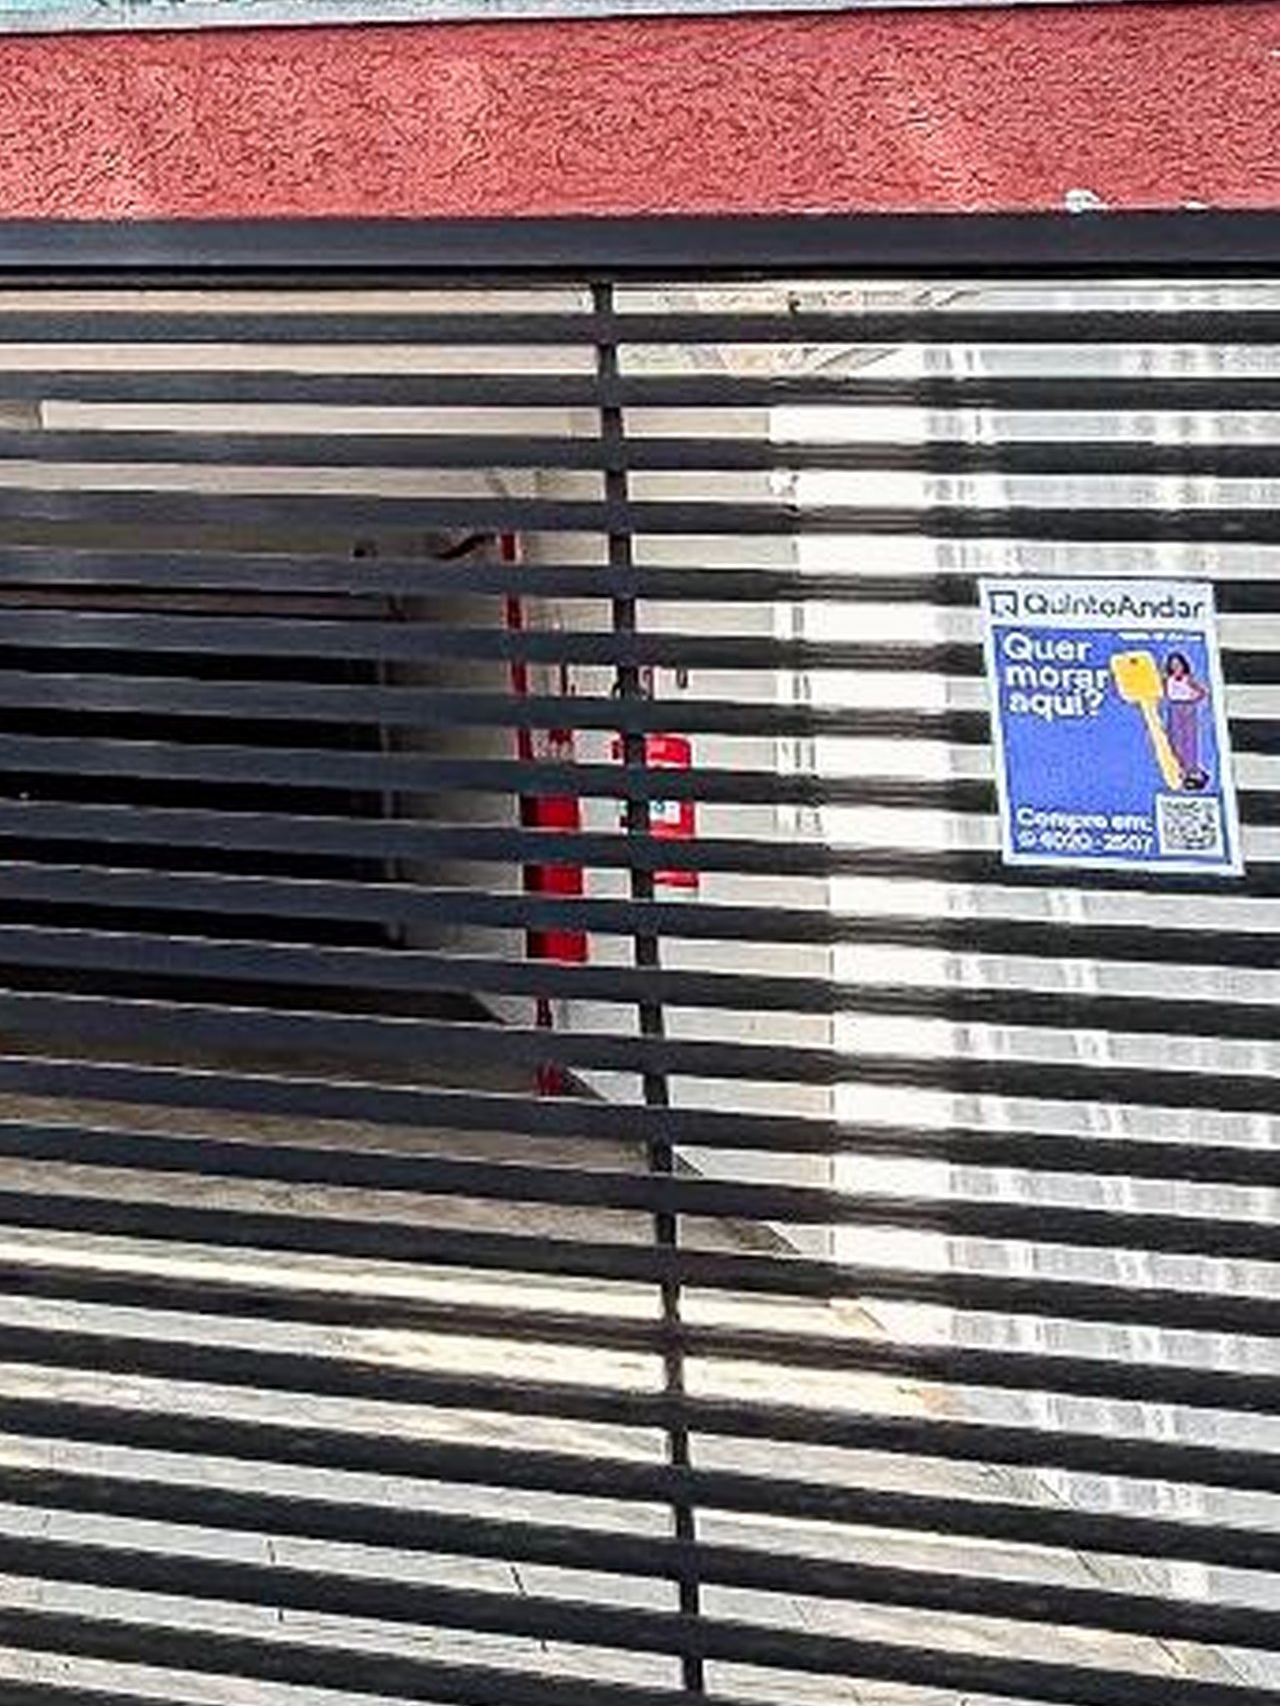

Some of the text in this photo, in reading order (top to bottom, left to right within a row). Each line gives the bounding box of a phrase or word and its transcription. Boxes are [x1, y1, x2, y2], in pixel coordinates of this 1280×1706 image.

[1023, 593, 1205, 618] QuintoAndar
[1003, 632, 1093, 661] Quer
[1006, 665, 1110, 689] morar
[1009, 691, 1104, 722] aqui?
